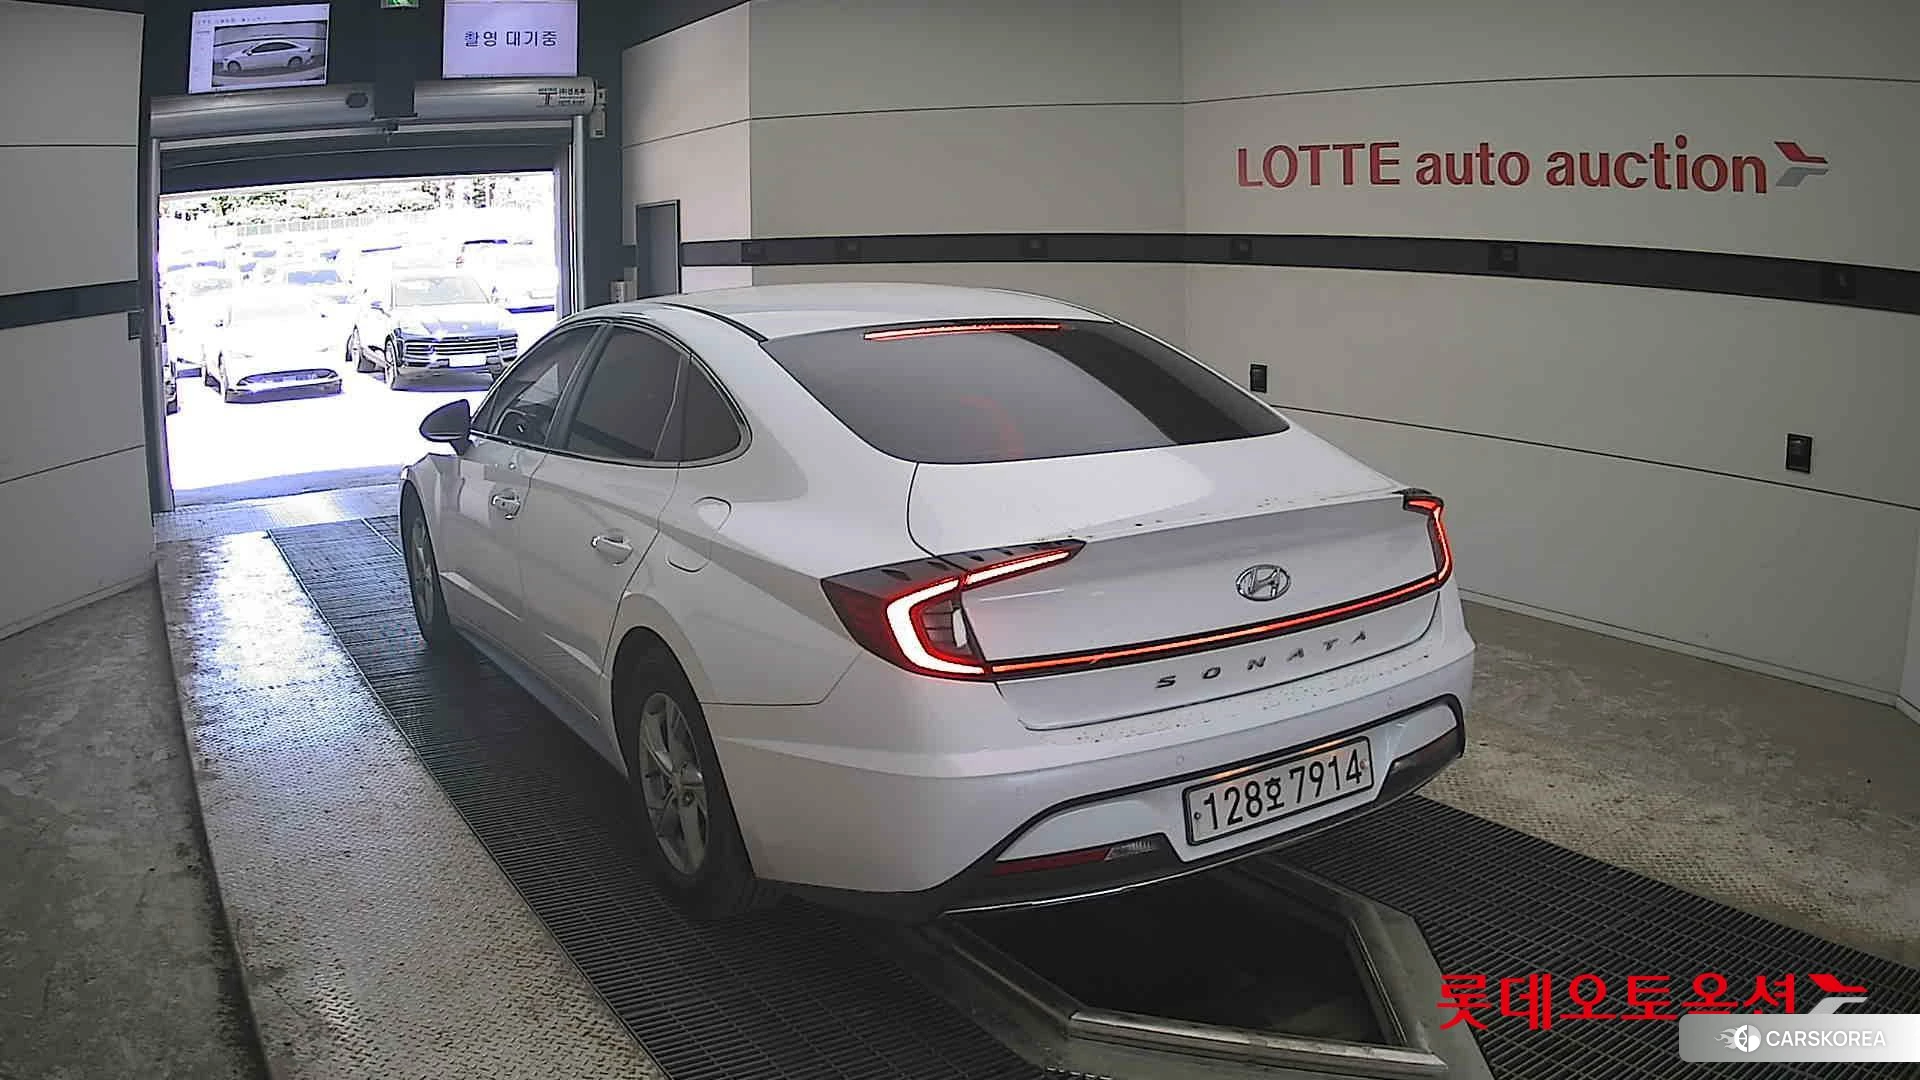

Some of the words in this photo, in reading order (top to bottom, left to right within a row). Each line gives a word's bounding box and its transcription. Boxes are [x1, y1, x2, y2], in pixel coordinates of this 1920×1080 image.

[505, 30, 558, 48] 대기중
[1237, 142, 1400, 188] LOTTE
[1415, 143, 1530, 186] auto
[1546, 134, 1767, 194] auction
[1155, 630, 1367, 689] SONATA
